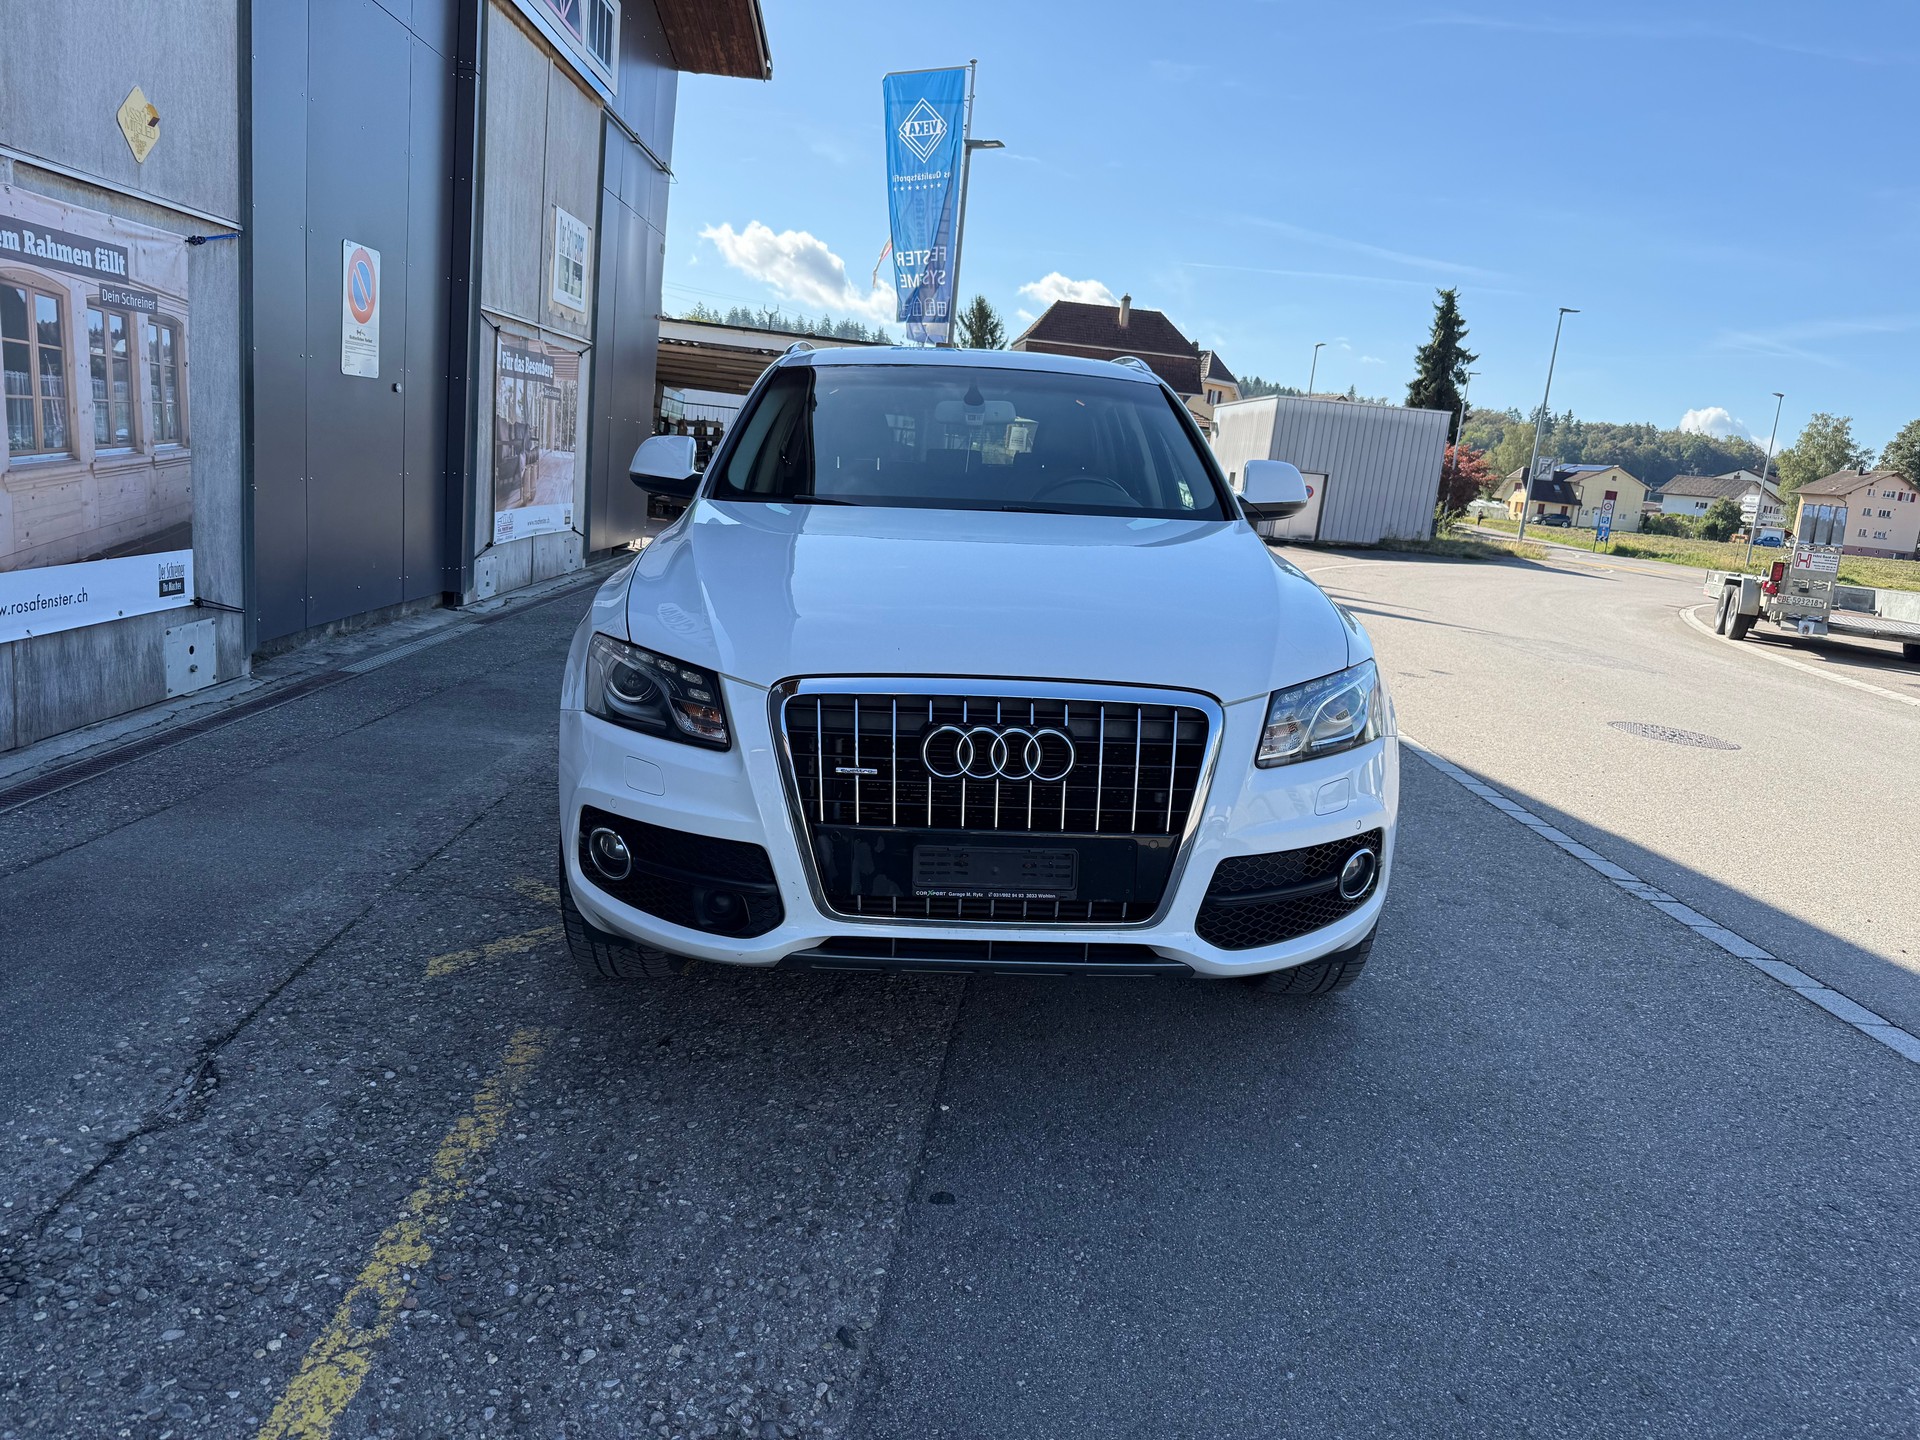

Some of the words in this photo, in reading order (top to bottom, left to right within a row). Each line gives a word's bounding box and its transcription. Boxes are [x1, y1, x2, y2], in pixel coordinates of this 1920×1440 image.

[23, 229, 92, 268] Rahmen
[95, 247, 126, 275] fällt
[102, 288, 120, 303] Dein
[121, 292, 155, 310] Schreiner
[502, 351, 513, 371] Für
[514, 353, 525, 373] das
[525, 356, 554, 379] Besondere
[0, 587, 88, 616] w.rosafenster.ch
